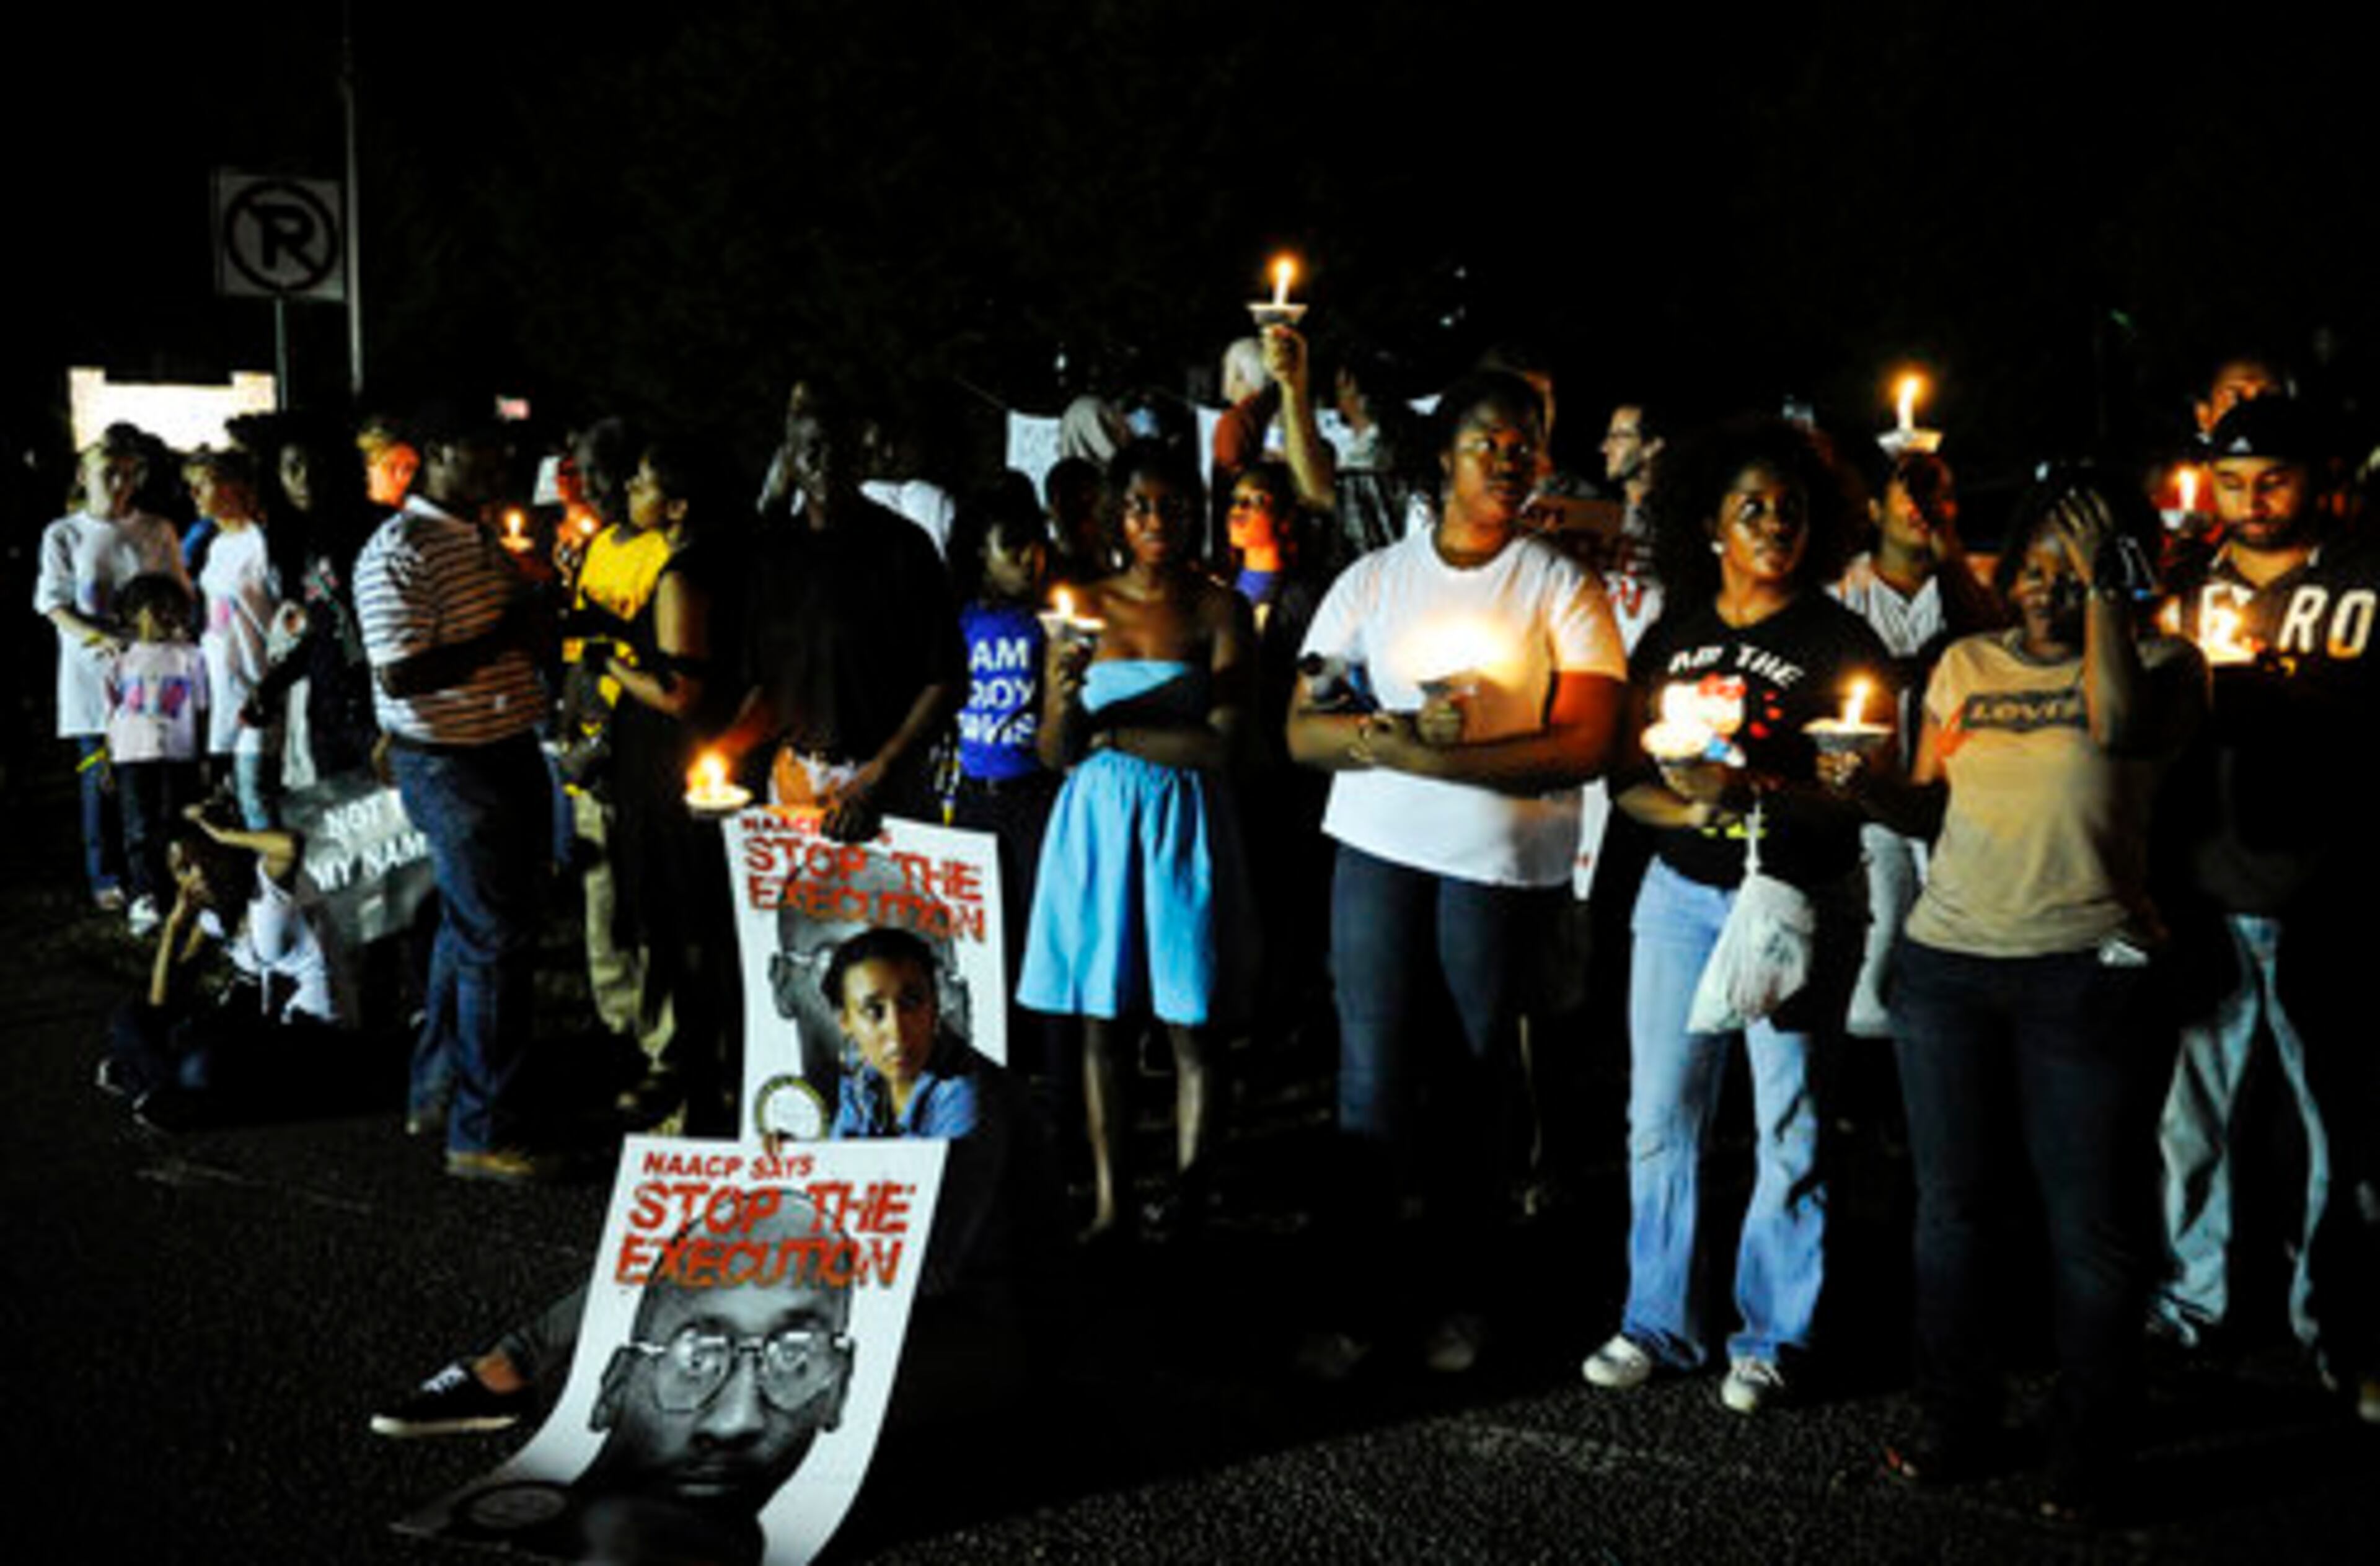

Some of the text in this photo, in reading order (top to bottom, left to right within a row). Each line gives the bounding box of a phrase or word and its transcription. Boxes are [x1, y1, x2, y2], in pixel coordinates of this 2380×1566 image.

[969, 636, 1031, 672] AM
[1735, 642, 1805, 692] THE
[745, 834, 984, 904] STOP THE
[747, 873, 987, 943] EXECUTION
[643, 1151, 816, 1181] NAACP SAYS
[627, 1179, 914, 1234] STOP THE
[615, 1233, 904, 1289] EXECUTION
